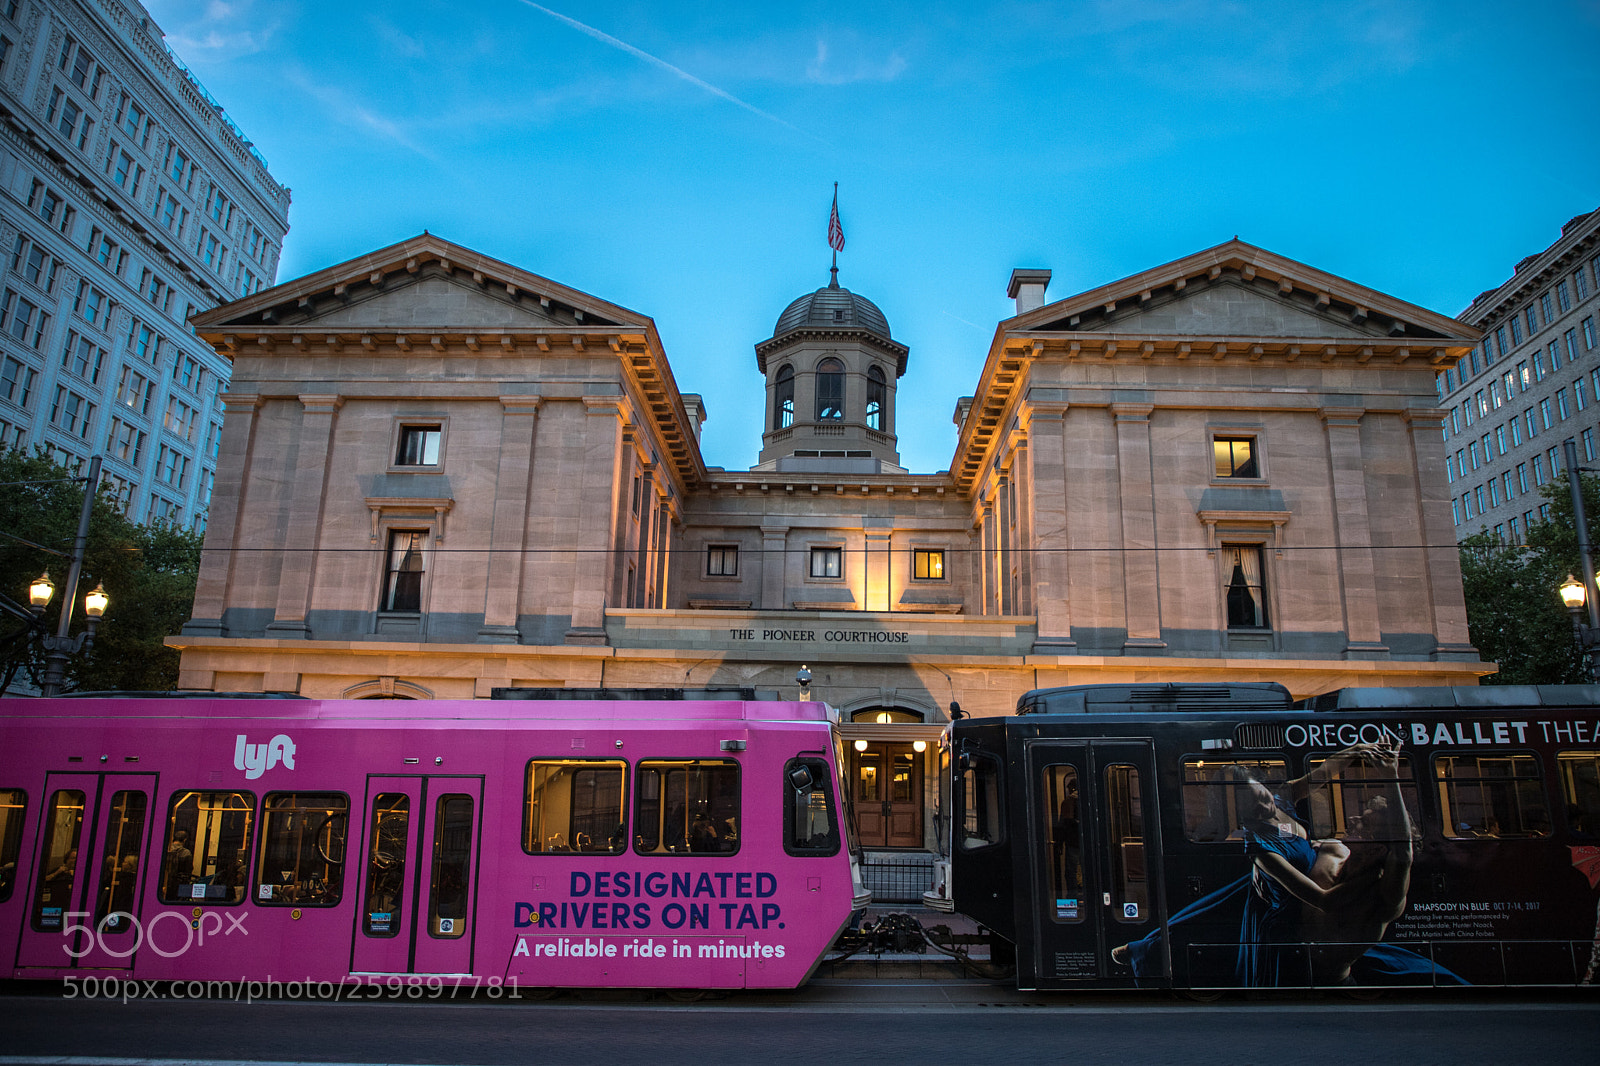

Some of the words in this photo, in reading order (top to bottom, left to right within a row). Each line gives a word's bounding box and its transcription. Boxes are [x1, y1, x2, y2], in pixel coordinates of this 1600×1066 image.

[730, 629, 755, 640] THE
[763, 629, 816, 641] PIONEER
[824, 630, 909, 643] COURTHOUSE
[1410, 721, 1529, 746] BALLET
[234, 734, 297, 780] lyft
[570, 871, 778, 899] DESIGNATED
[514, 902, 651, 929] DRIVERS
[661, 902, 711, 930] ON
[719, 902, 786, 930] TAP.
[1405, 914, 1431, 922] Featuring
[1502, 912, 1510, 921] by
[1413, 902, 1458, 911] RHAPSODY
[1459, 902, 1470, 911] IN
[1470, 902, 1490, 911] BLUE
[1493, 902, 1505, 910] OCT
[1525, 901, 1540, 910] 2017
[513, 938, 530, 957] A
[534, 938, 617, 958] reliable
[623, 938, 666, 958] ride
[672, 938, 693, 958] in
[698, 939, 786, 959] minutes
